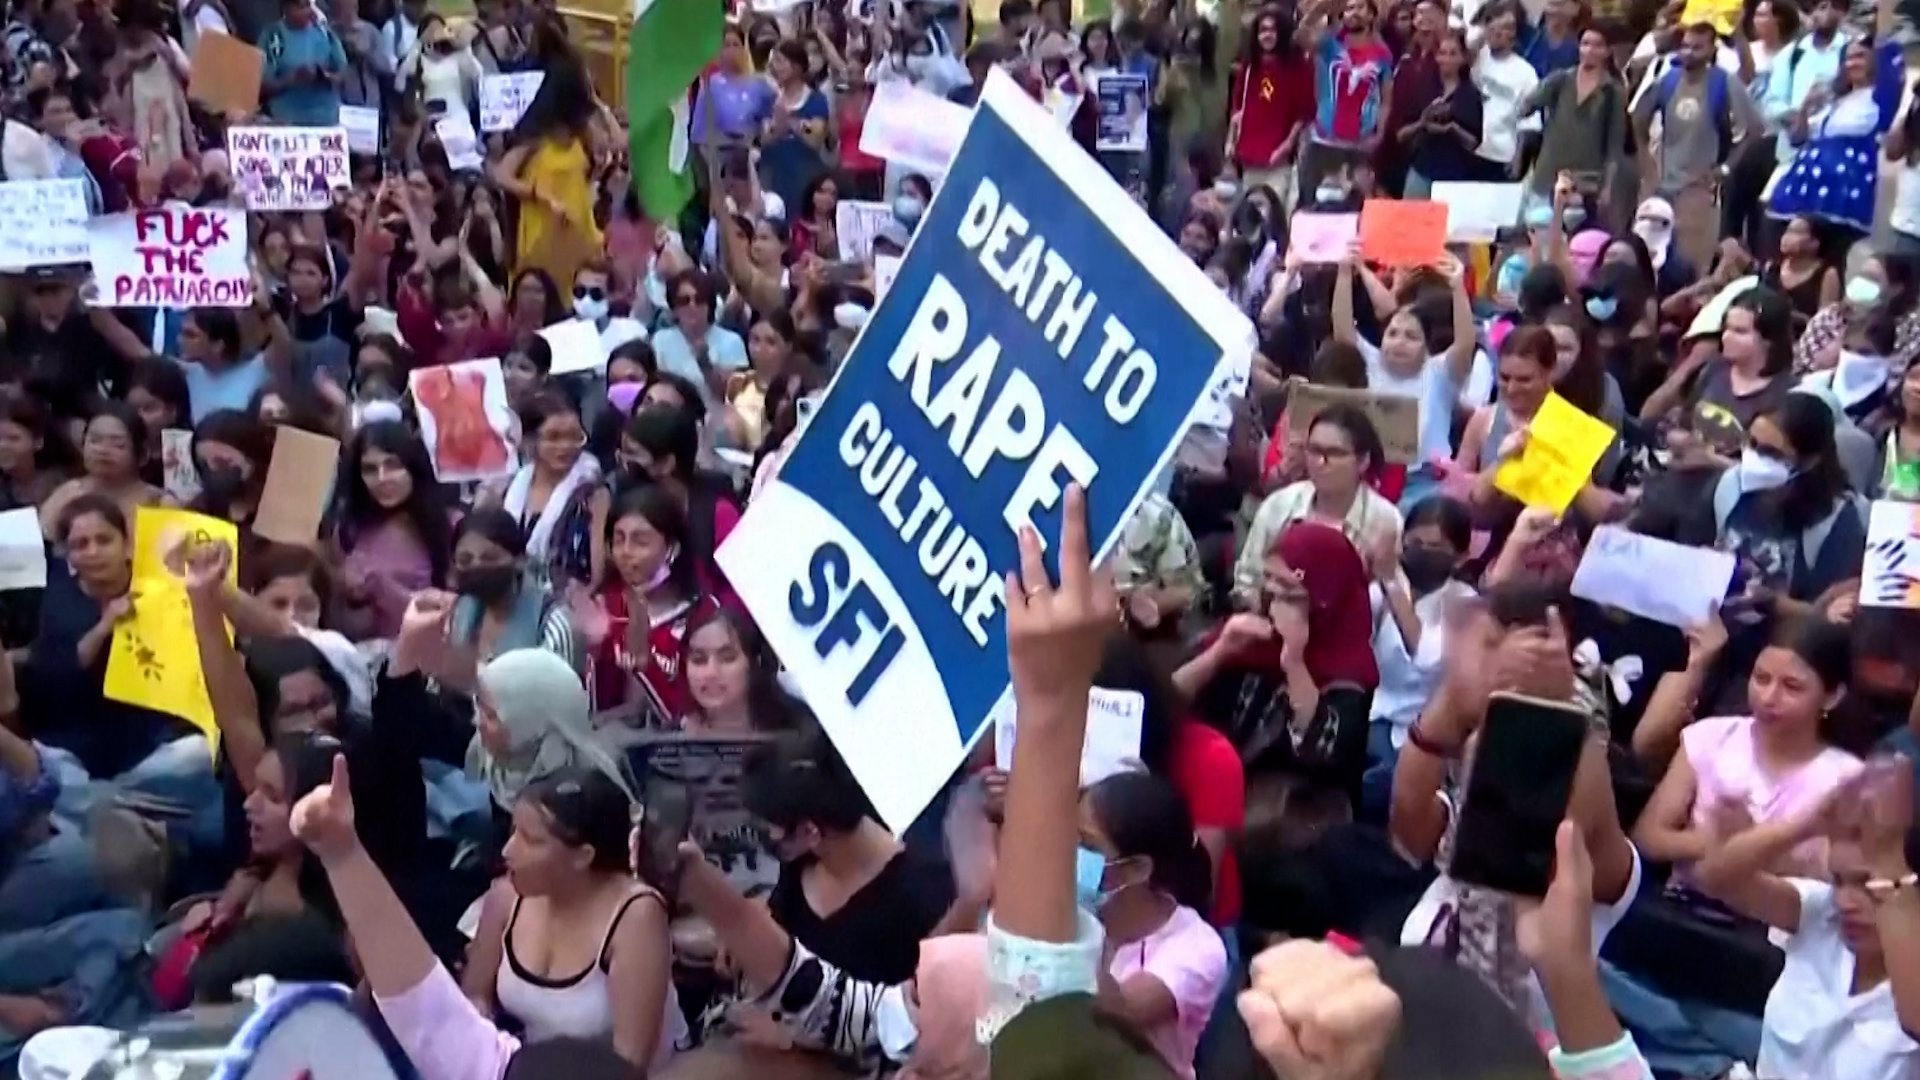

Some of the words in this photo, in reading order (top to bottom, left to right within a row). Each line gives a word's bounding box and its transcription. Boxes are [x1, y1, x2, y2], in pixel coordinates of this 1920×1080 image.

[134, 247, 203, 275] THE
[136, 210, 229, 247] FUCK
[956, 176, 1098, 360] DEATH
[1082, 314, 1158, 425] TO
[887, 272, 1100, 552] RAPE
[788, 541, 907, 707] SFI
[838, 402, 1010, 648] CULTURE
